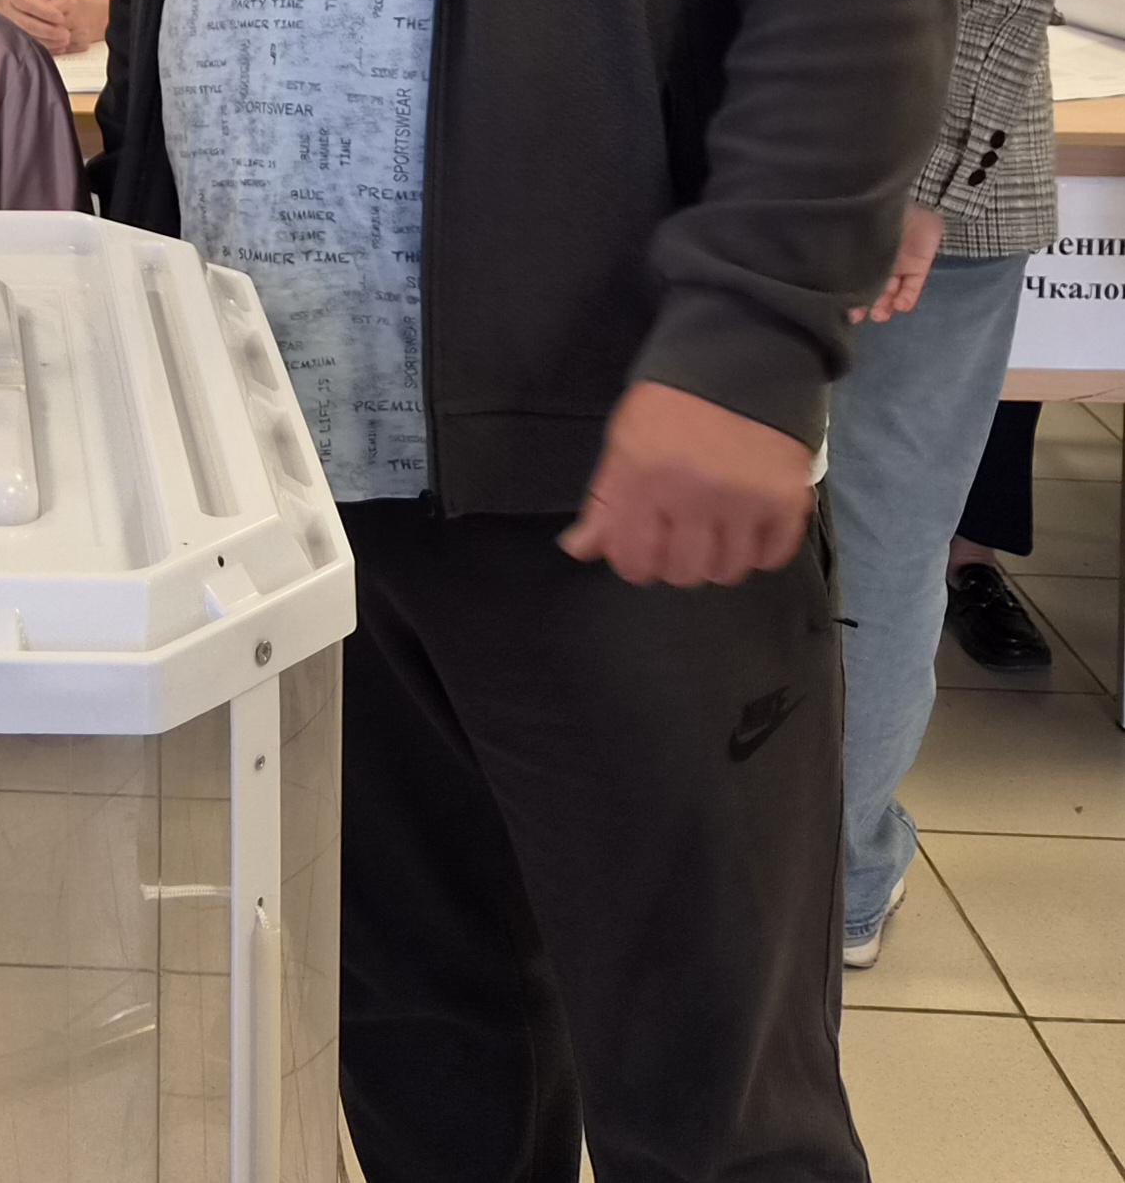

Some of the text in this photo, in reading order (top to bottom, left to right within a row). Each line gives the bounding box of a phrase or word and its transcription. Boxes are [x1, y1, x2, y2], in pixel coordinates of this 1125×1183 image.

[272, 19, 305, 30] TIME
[393, 16, 431, 31] THE
[235, 100, 314, 117] SPORTSWEAR
[393, 87, 413, 183] SPORTSWEAR
[340, 137, 352, 166] TIME
[290, 188, 326, 202] BLUE
[278, 210, 337, 224] SUMMER
[290, 229, 327, 241] TIME
[237, 247, 296, 266] SUMMER
[301, 249, 351, 264] TIME
[403, 315, 420, 390] SPORTSWEAR
[318, 399, 332, 433] LIFE
[387, 458, 425, 471] THE
